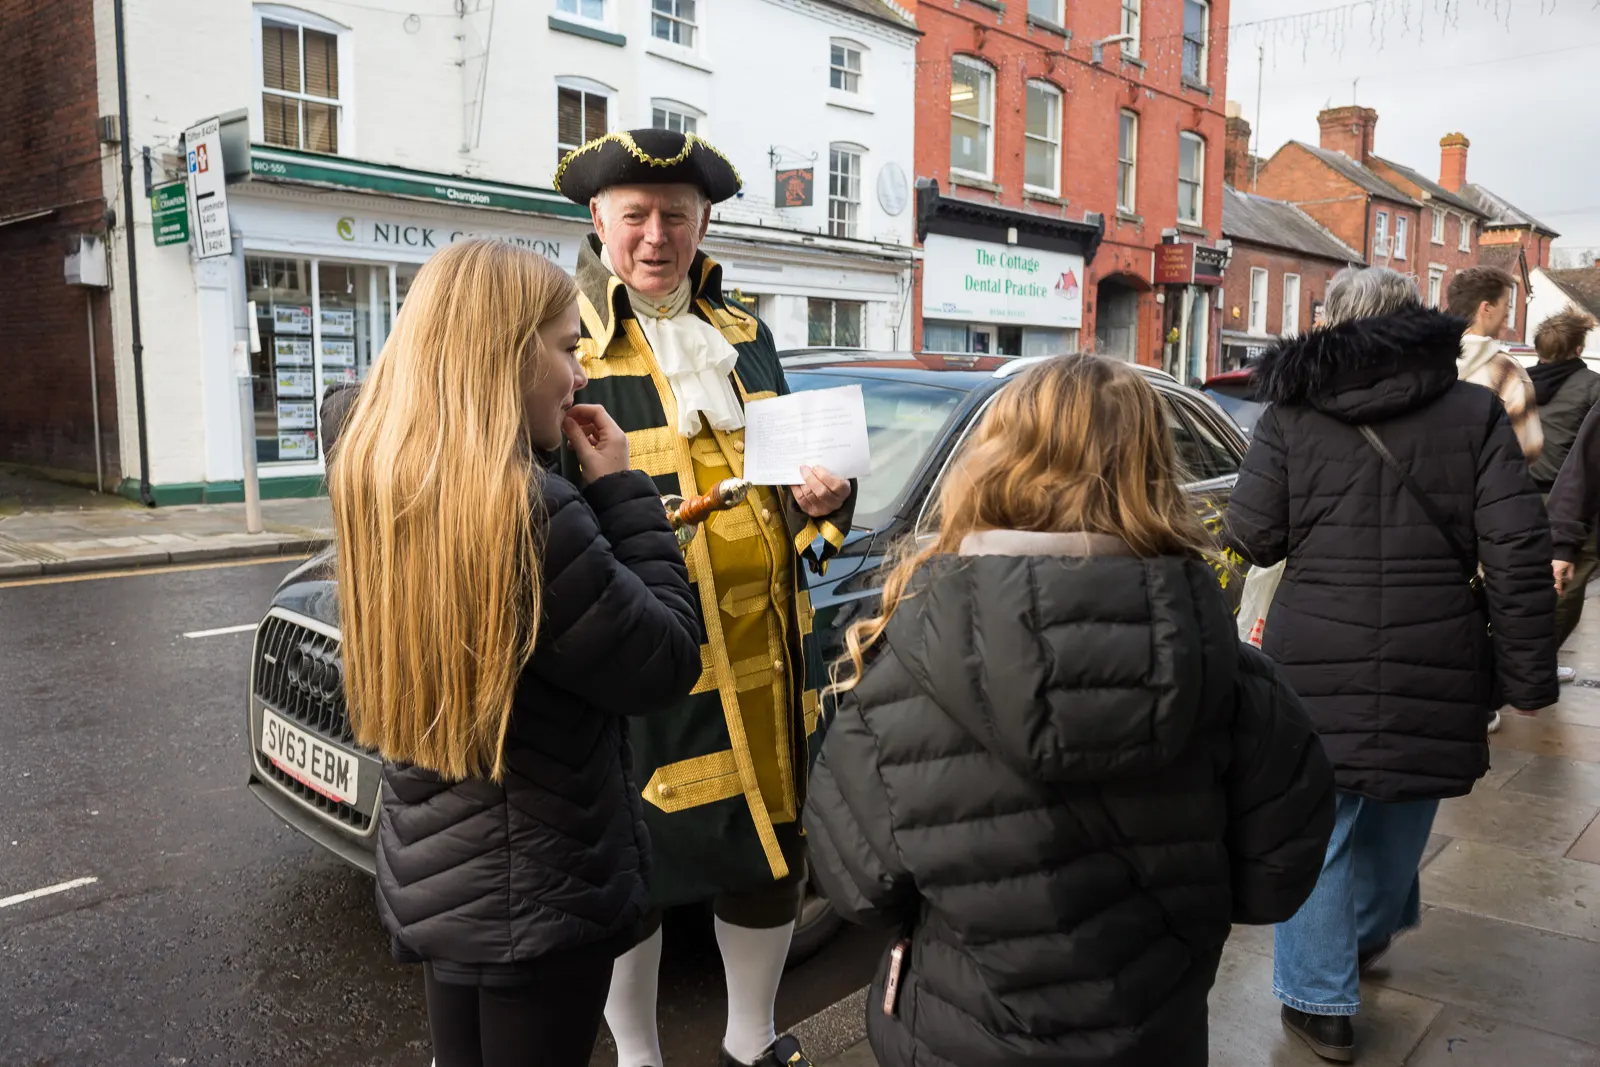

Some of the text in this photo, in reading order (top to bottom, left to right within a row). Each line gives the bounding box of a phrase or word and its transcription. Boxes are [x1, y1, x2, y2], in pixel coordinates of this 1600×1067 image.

[447, 188, 490, 204] Champion
[373, 223, 437, 248] NICK
[976, 248, 1040, 275] The Cottage
[965, 275, 1047, 298] Dental Practice
[268, 718, 307, 769] SV63
[311, 743, 349, 793] EBM
